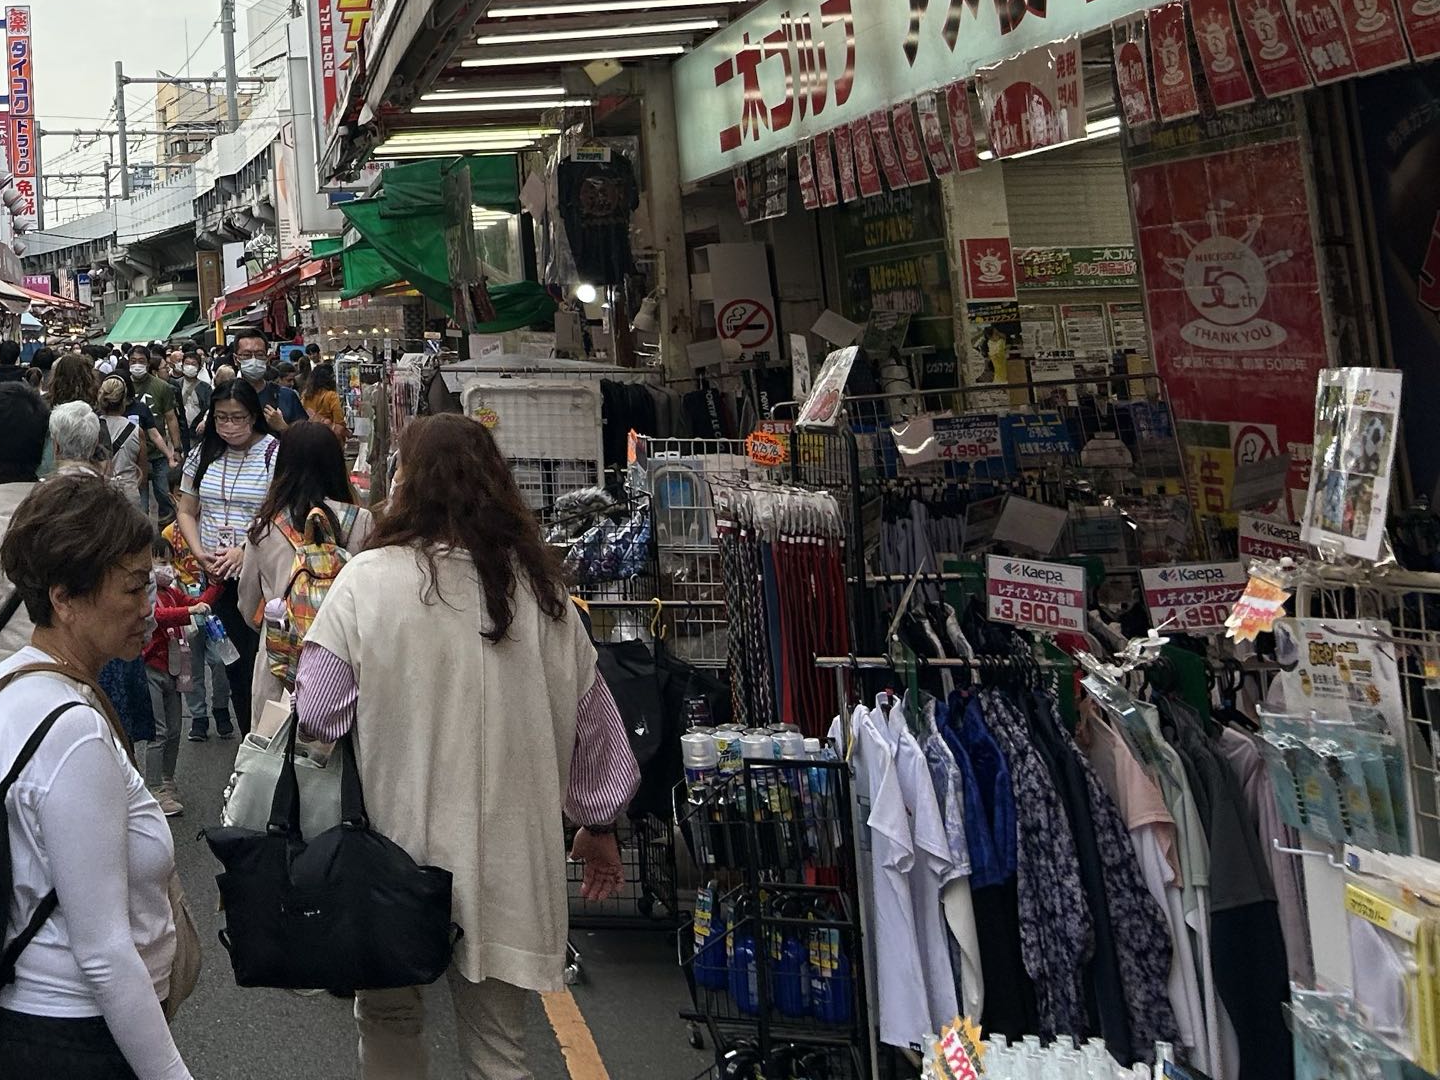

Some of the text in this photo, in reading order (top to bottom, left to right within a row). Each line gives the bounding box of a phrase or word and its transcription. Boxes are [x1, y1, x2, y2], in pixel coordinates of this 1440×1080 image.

[9, 8, 29, 33] 薬
[1194, 325, 1272, 343] THANK YOU
[1267, 522, 1300, 543] Kaepa
[1021, 564, 1063, 582] Kaepa
[1178, 567, 1225, 583] Kaepa
[997, 584, 1029, 598] レディス
[994, 599, 1060, 626] ¥3,900
